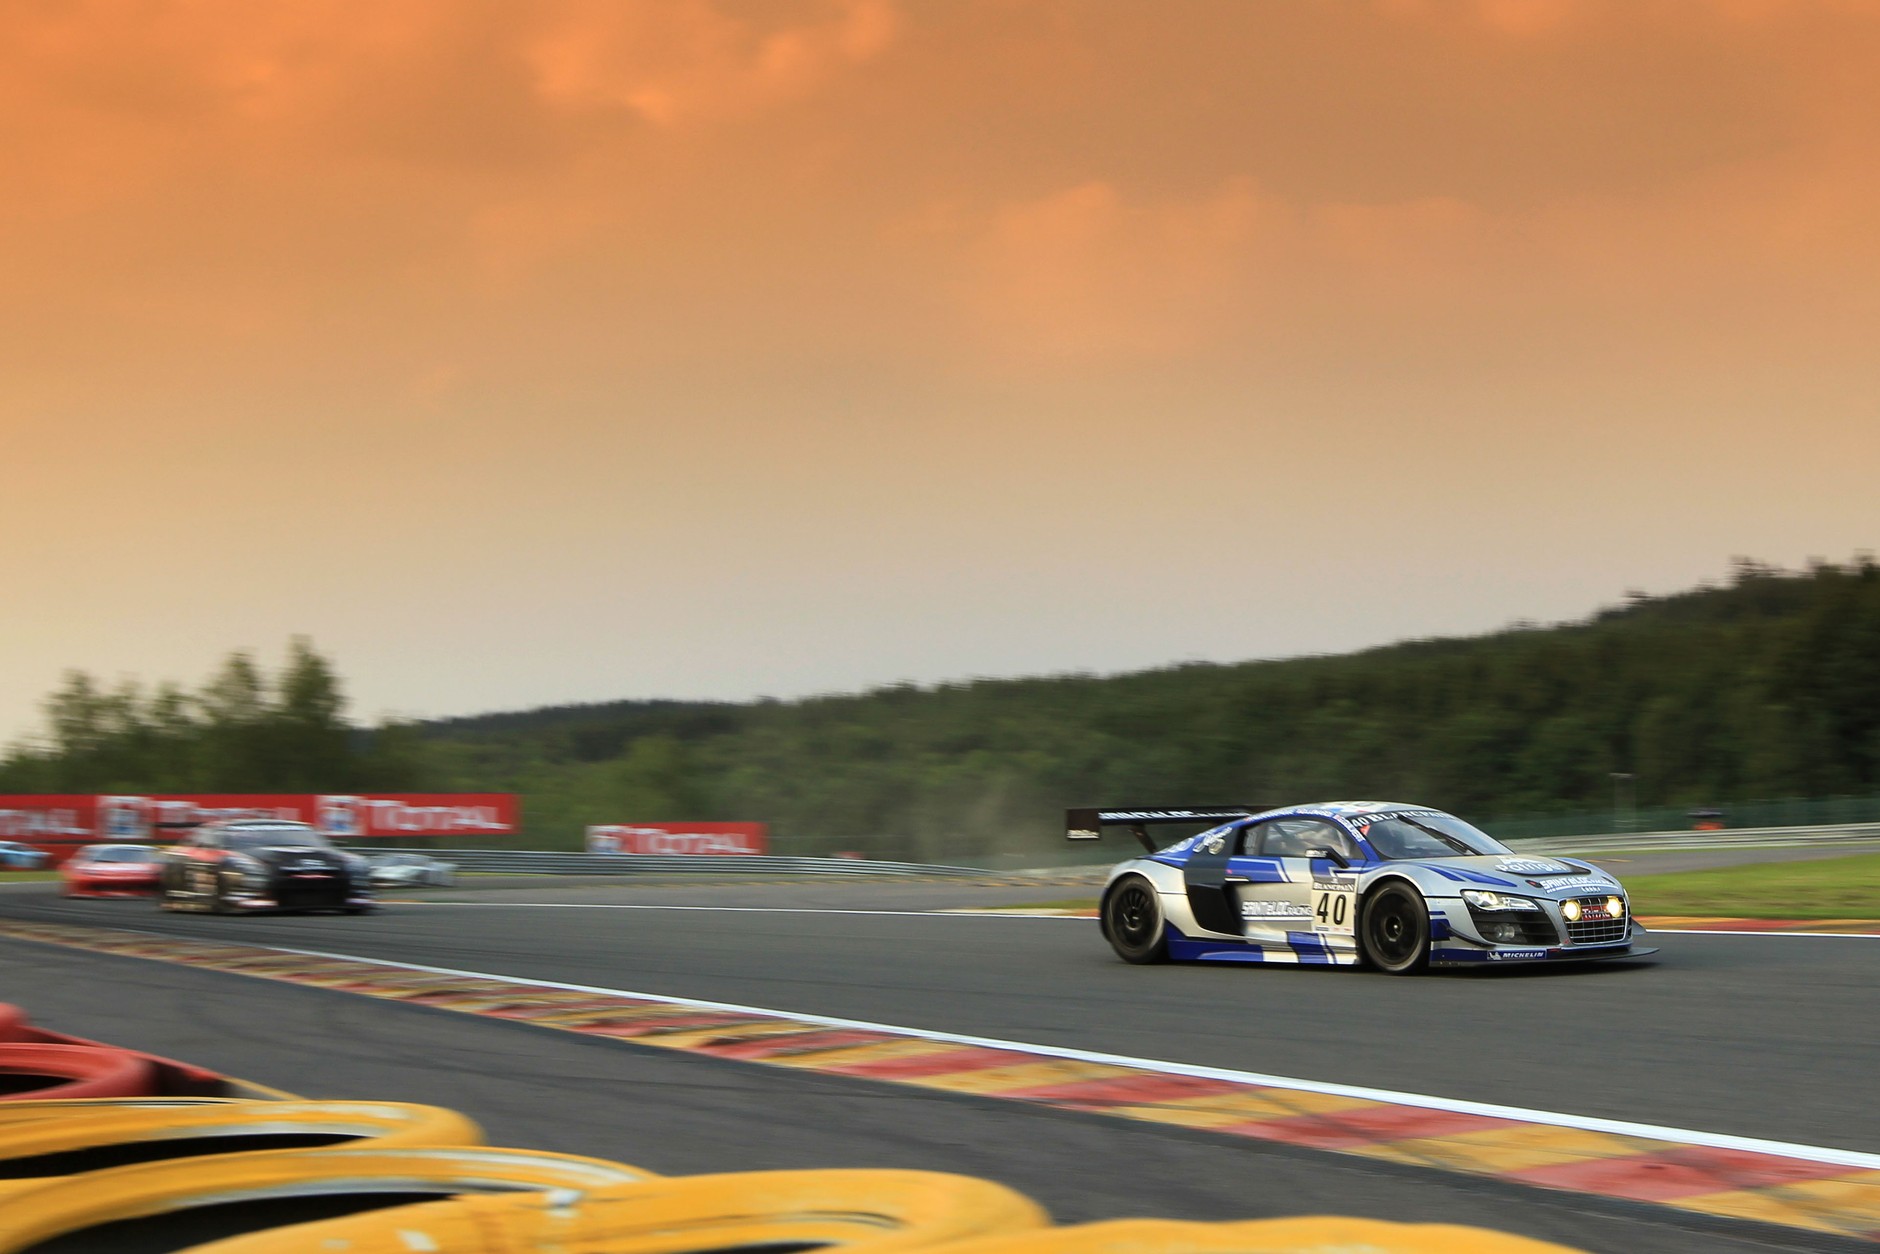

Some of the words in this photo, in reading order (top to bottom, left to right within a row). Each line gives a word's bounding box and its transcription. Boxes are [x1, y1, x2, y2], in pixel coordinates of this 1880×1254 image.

[366, 800, 509, 830] TOTAL
[1351, 816, 1370, 828] 40
[620, 827, 760, 855] TOTAL
[1316, 892, 1345, 925] 40
